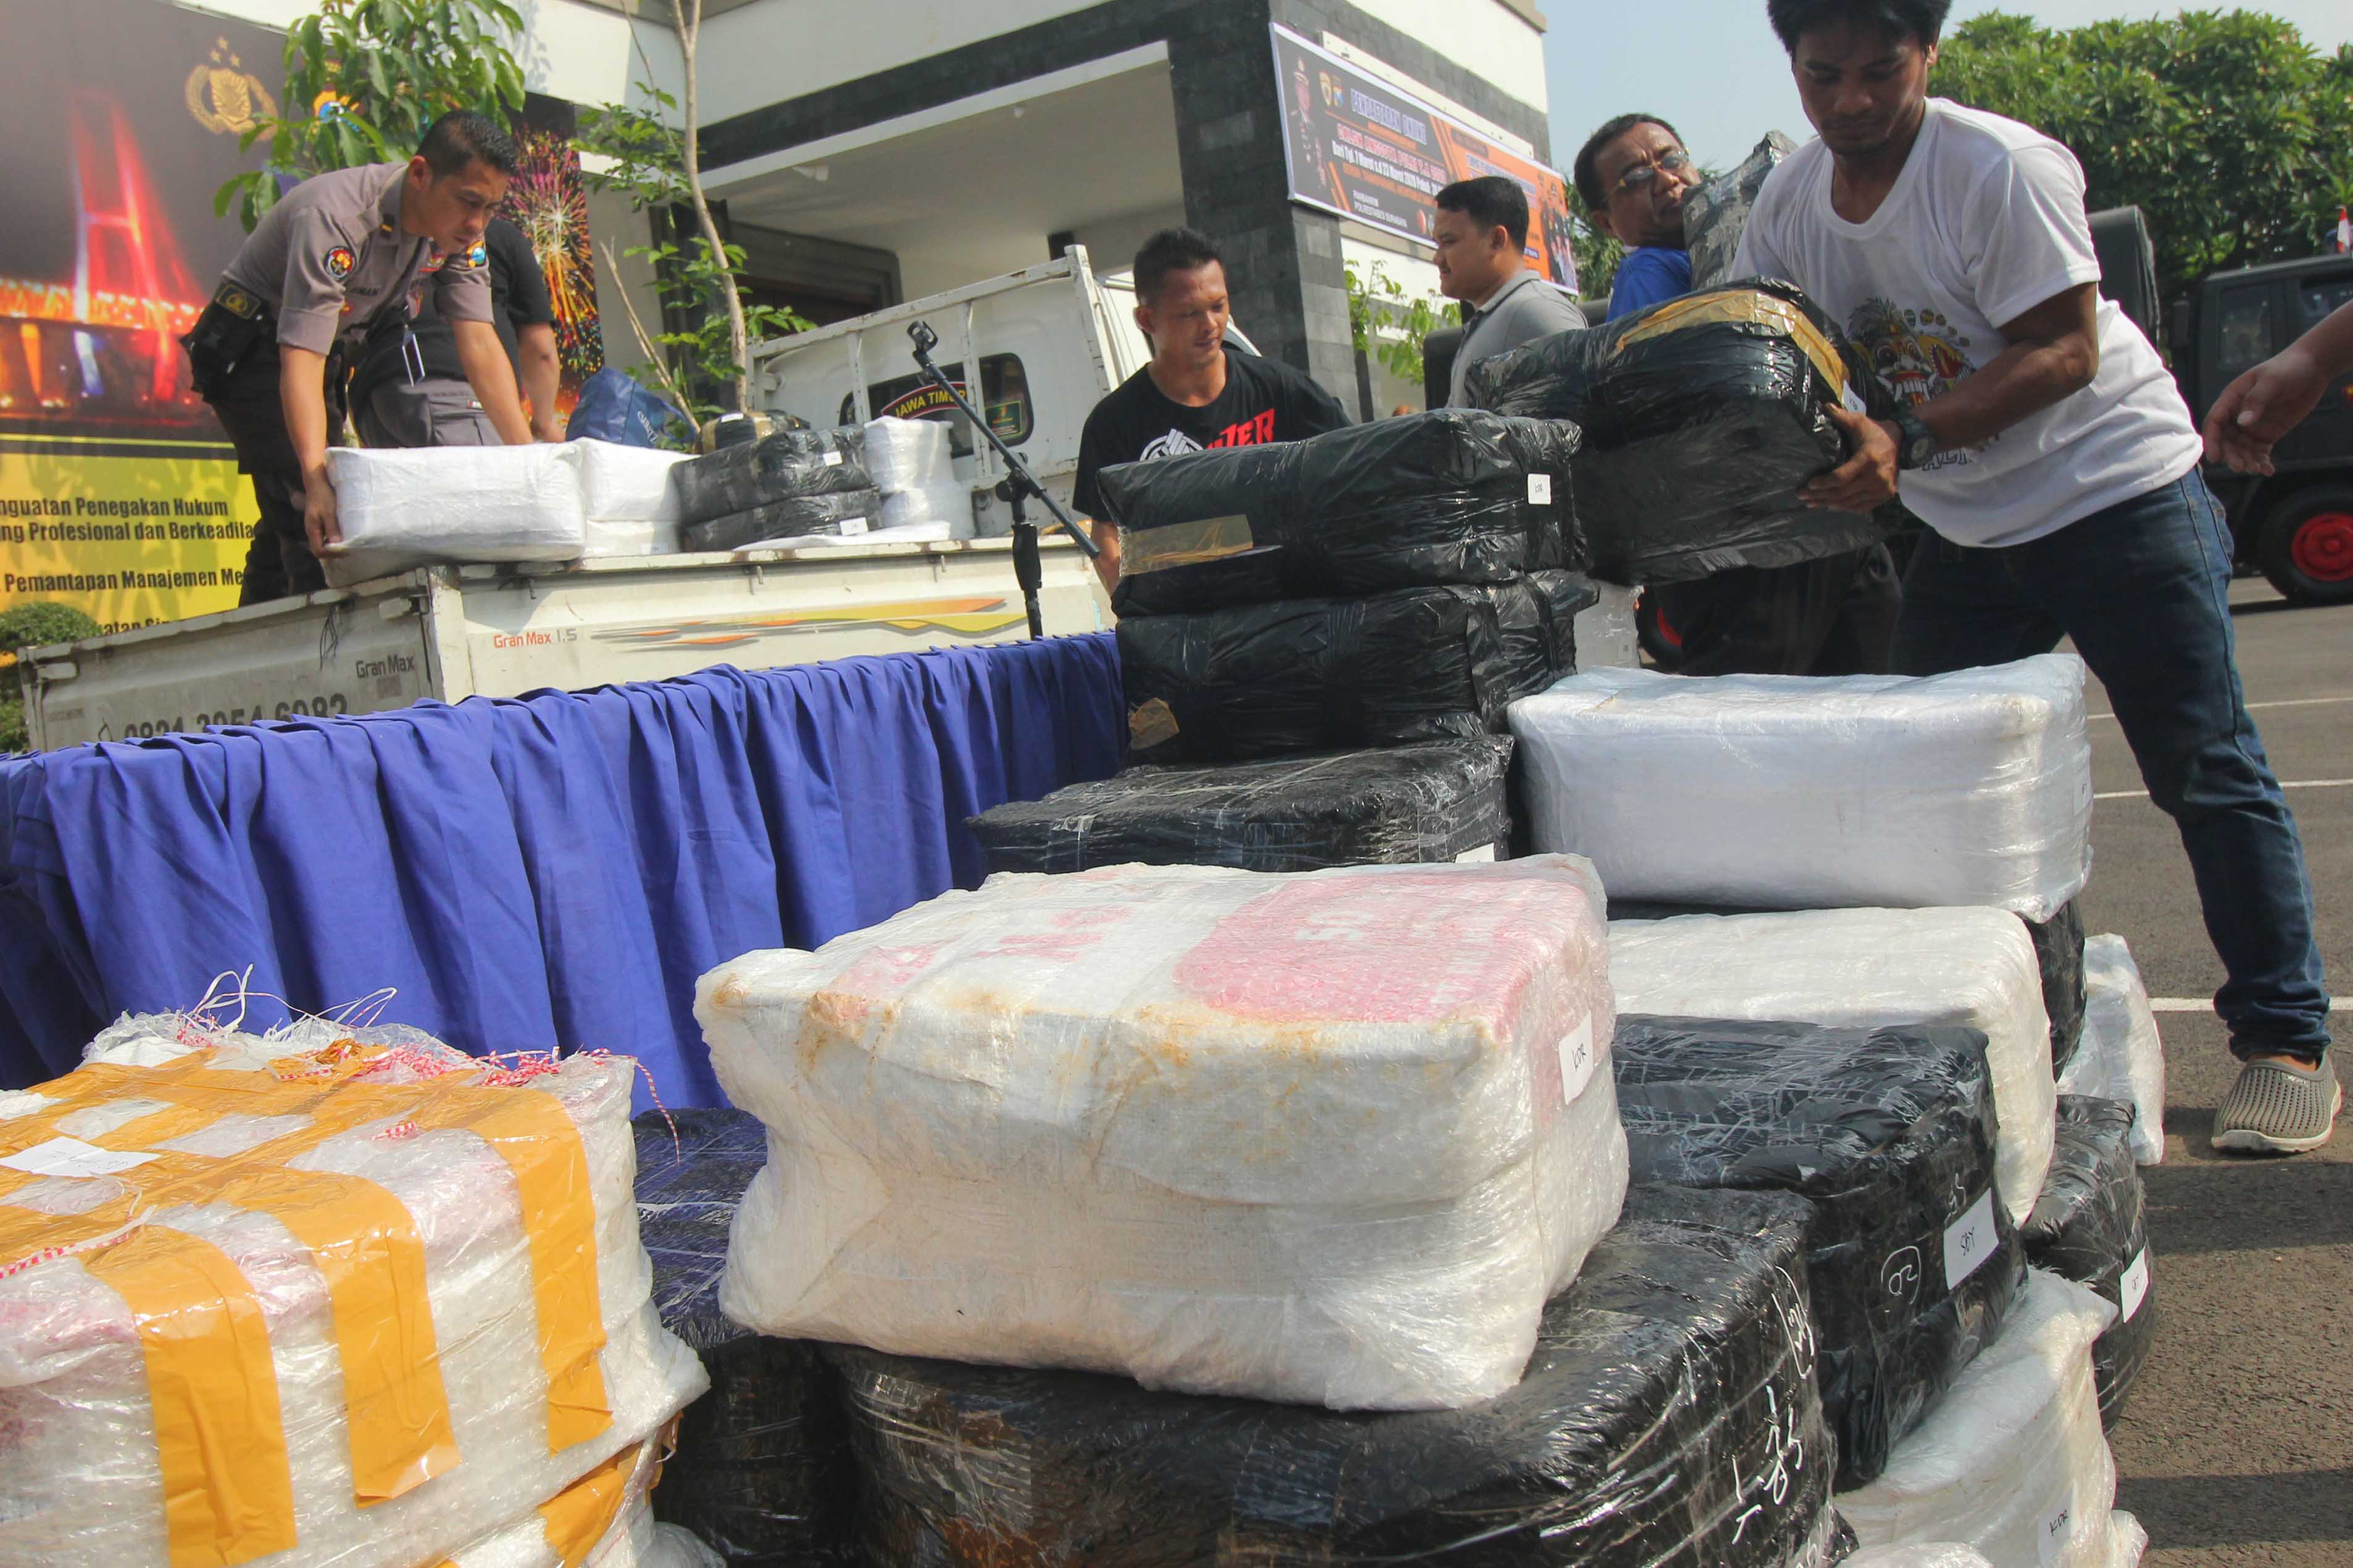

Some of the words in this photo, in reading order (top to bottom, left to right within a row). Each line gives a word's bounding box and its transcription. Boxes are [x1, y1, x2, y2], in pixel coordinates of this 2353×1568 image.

[895, 395, 926, 418] JAWA
[76, 497, 169, 518] Penegakan
[174, 499, 228, 516] Hukum
[1, 525, 24, 542] ng
[29, 522, 130, 541] Profesional
[135, 523, 166, 539] dan
[5, 573, 118, 592] Pemantapan
[122, 570, 218, 589] Manajemen
[494, 634, 523, 649] Gran
[526, 631, 552, 646] Max
[557, 628, 577, 643] 1.5
[356, 660, 386, 678] Gran
[387, 654, 415, 673] Max
[2049, 1509, 2068, 1538] KDR
